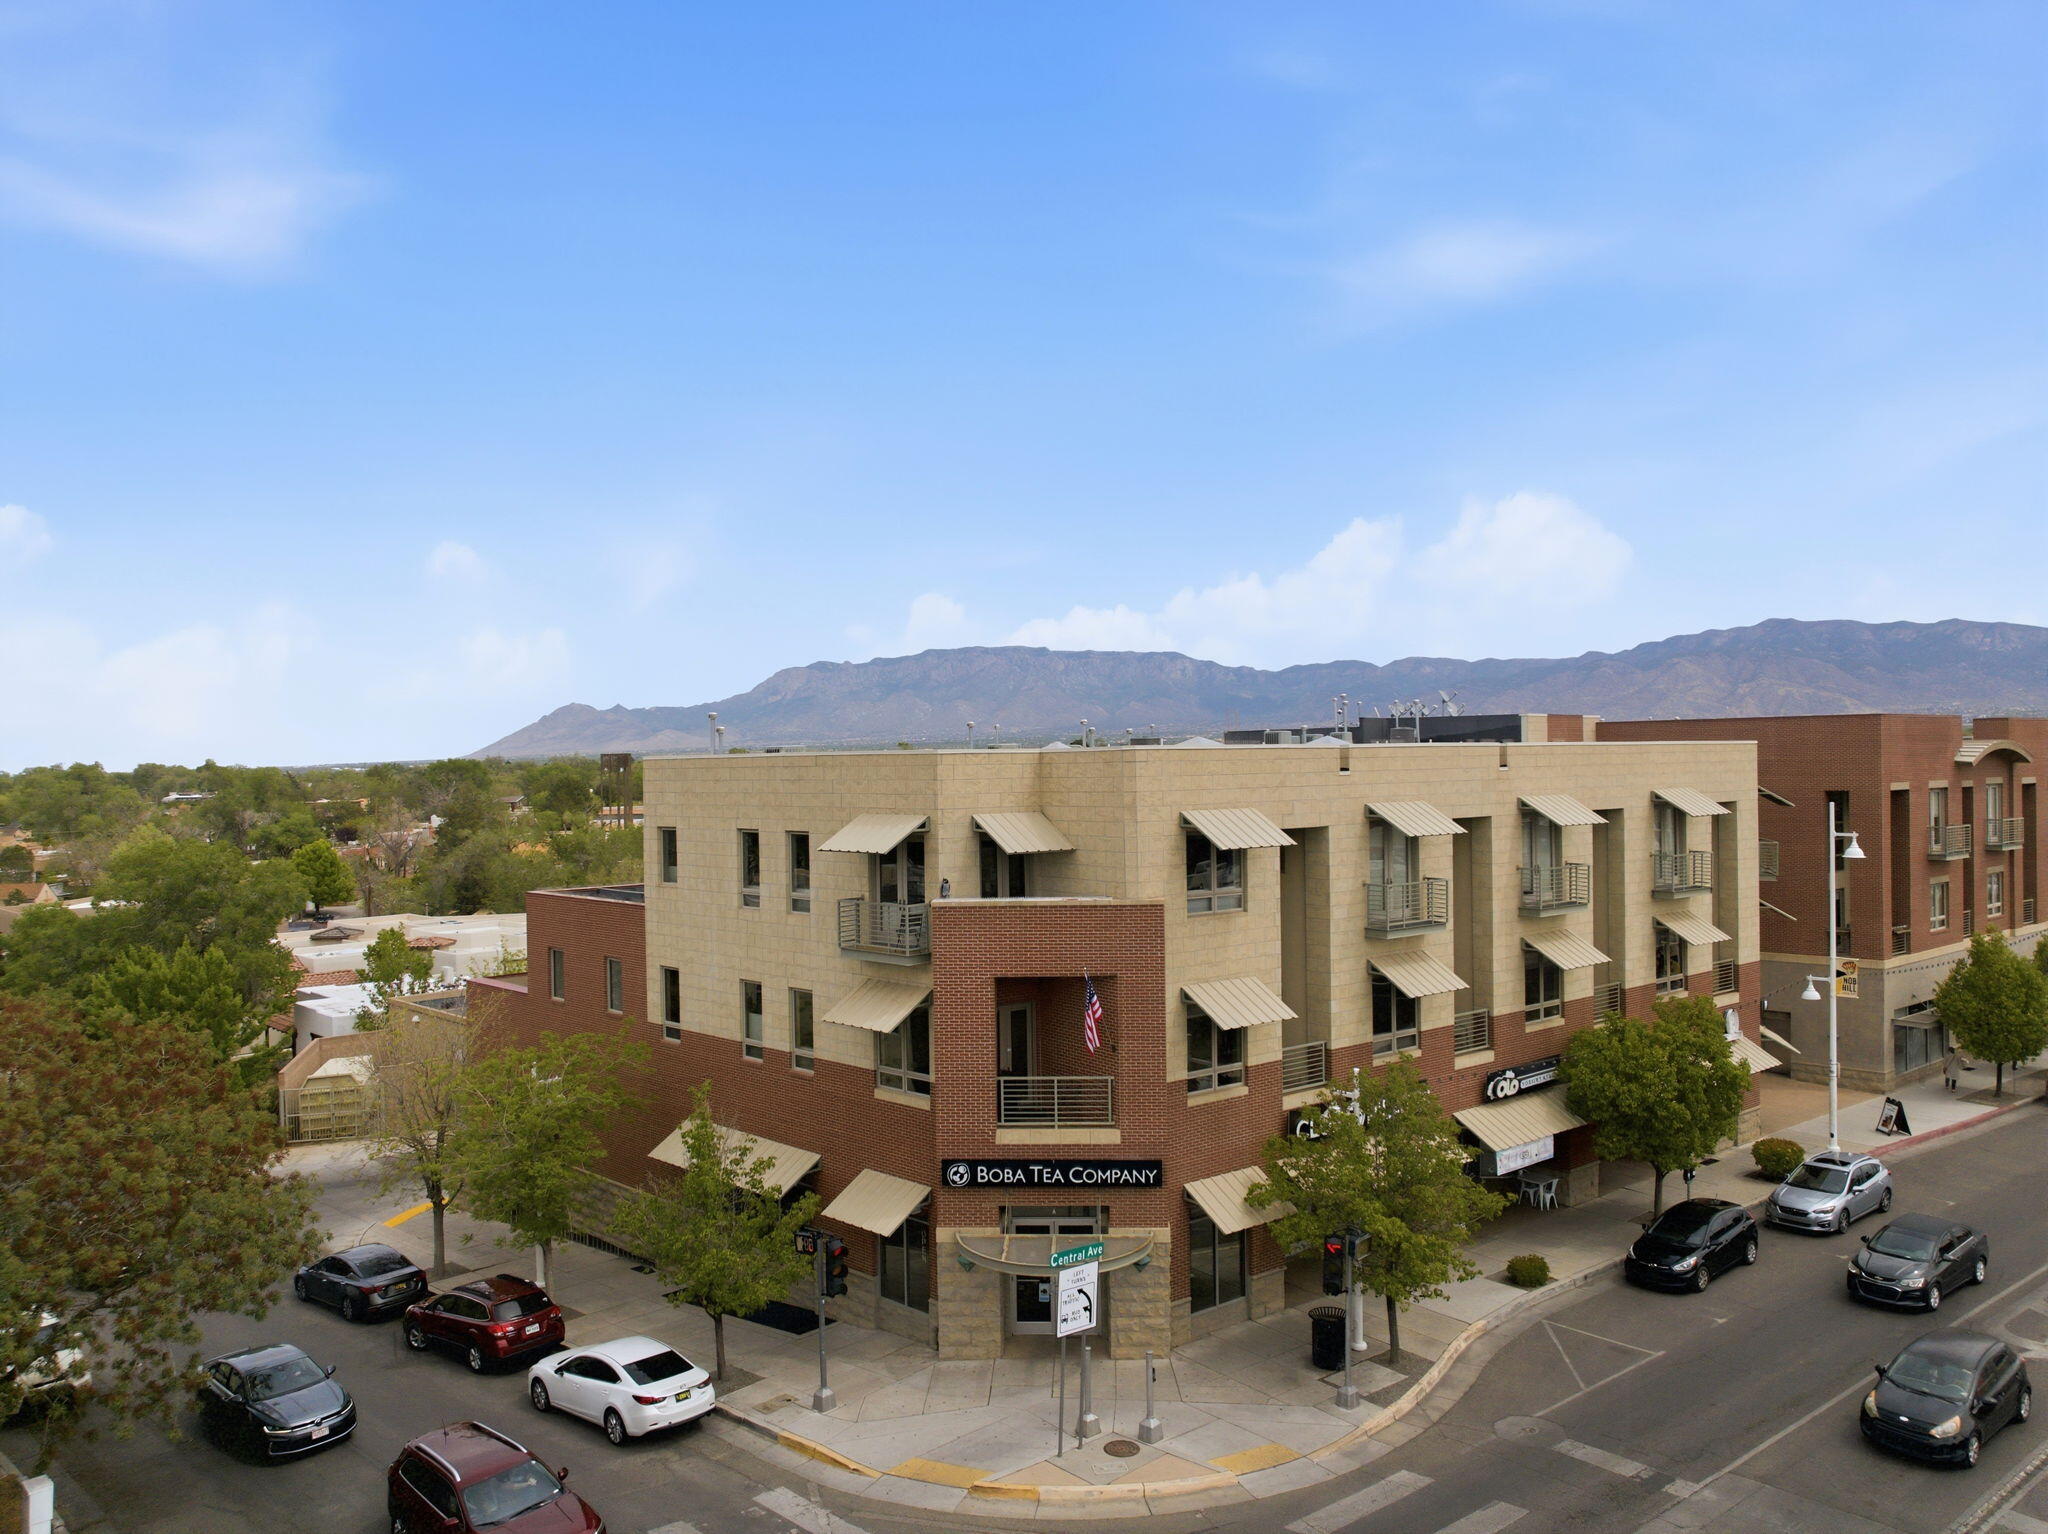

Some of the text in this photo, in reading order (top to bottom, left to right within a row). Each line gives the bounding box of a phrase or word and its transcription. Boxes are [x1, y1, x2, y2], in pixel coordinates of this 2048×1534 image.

[1843, 977, 1856, 985] NOB
[976, 1166, 1158, 1184] BOBA TEA COMPANY
[1051, 1246, 1103, 1267] Central Ave
